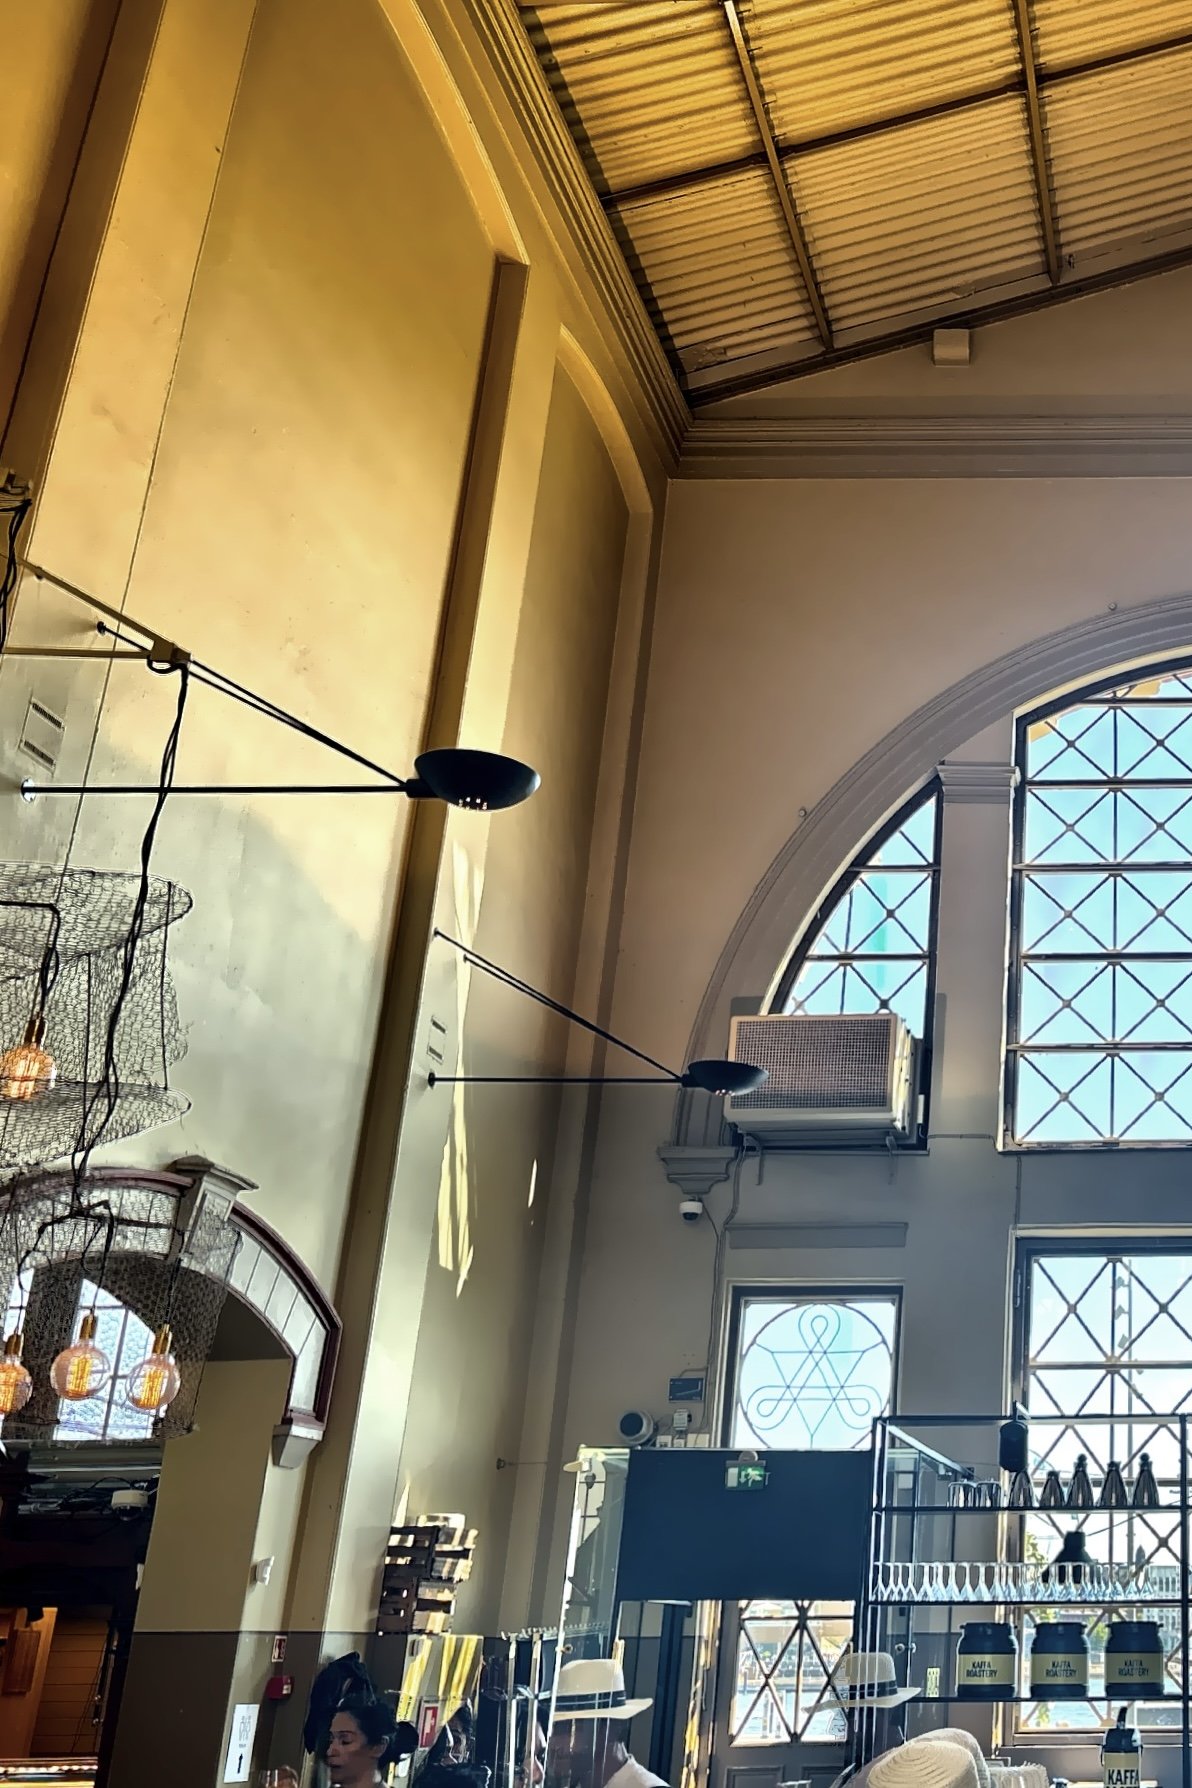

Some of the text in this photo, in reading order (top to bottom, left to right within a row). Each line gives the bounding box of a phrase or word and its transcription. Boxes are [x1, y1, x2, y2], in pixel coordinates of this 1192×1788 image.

[972, 1660, 991, 1669] KAFFA
[1051, 1660, 1071, 1669] KAFFA
[1124, 1659, 1143, 1667] KAFFA
[965, 1669, 998, 1678] ROASTERY
[1045, 1669, 1078, 1678] ROASTERY
[1117, 1667, 1150, 1677] ROASTERY
[1108, 1769, 1139, 1785] KAFFA
